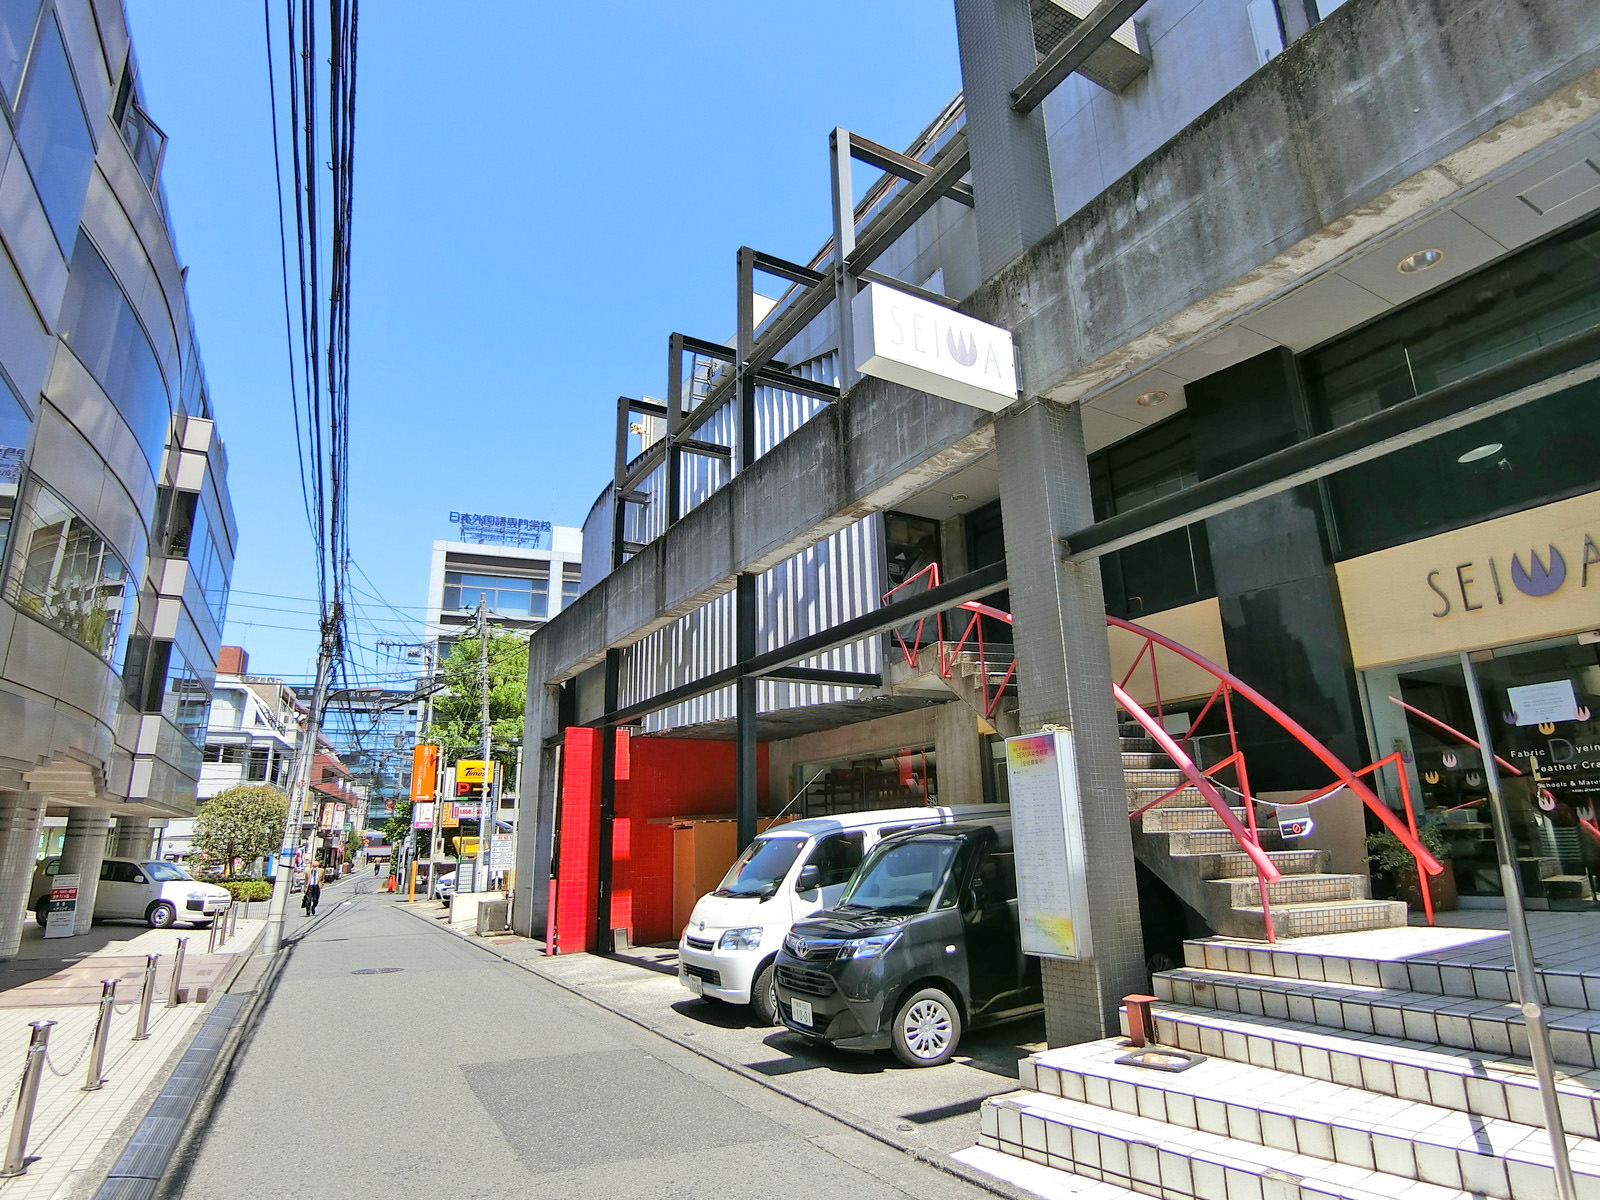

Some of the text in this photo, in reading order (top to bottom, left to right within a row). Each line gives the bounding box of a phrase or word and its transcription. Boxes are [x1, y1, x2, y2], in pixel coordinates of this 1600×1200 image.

[890, 305, 1002, 379] SEIWA
[449, 511, 552, 533] 日本外国語専門学校
[1427, 533, 1600, 618] SEIWA
[1510, 748, 1546, 758] Fabric
[457, 782, 470, 796] P
